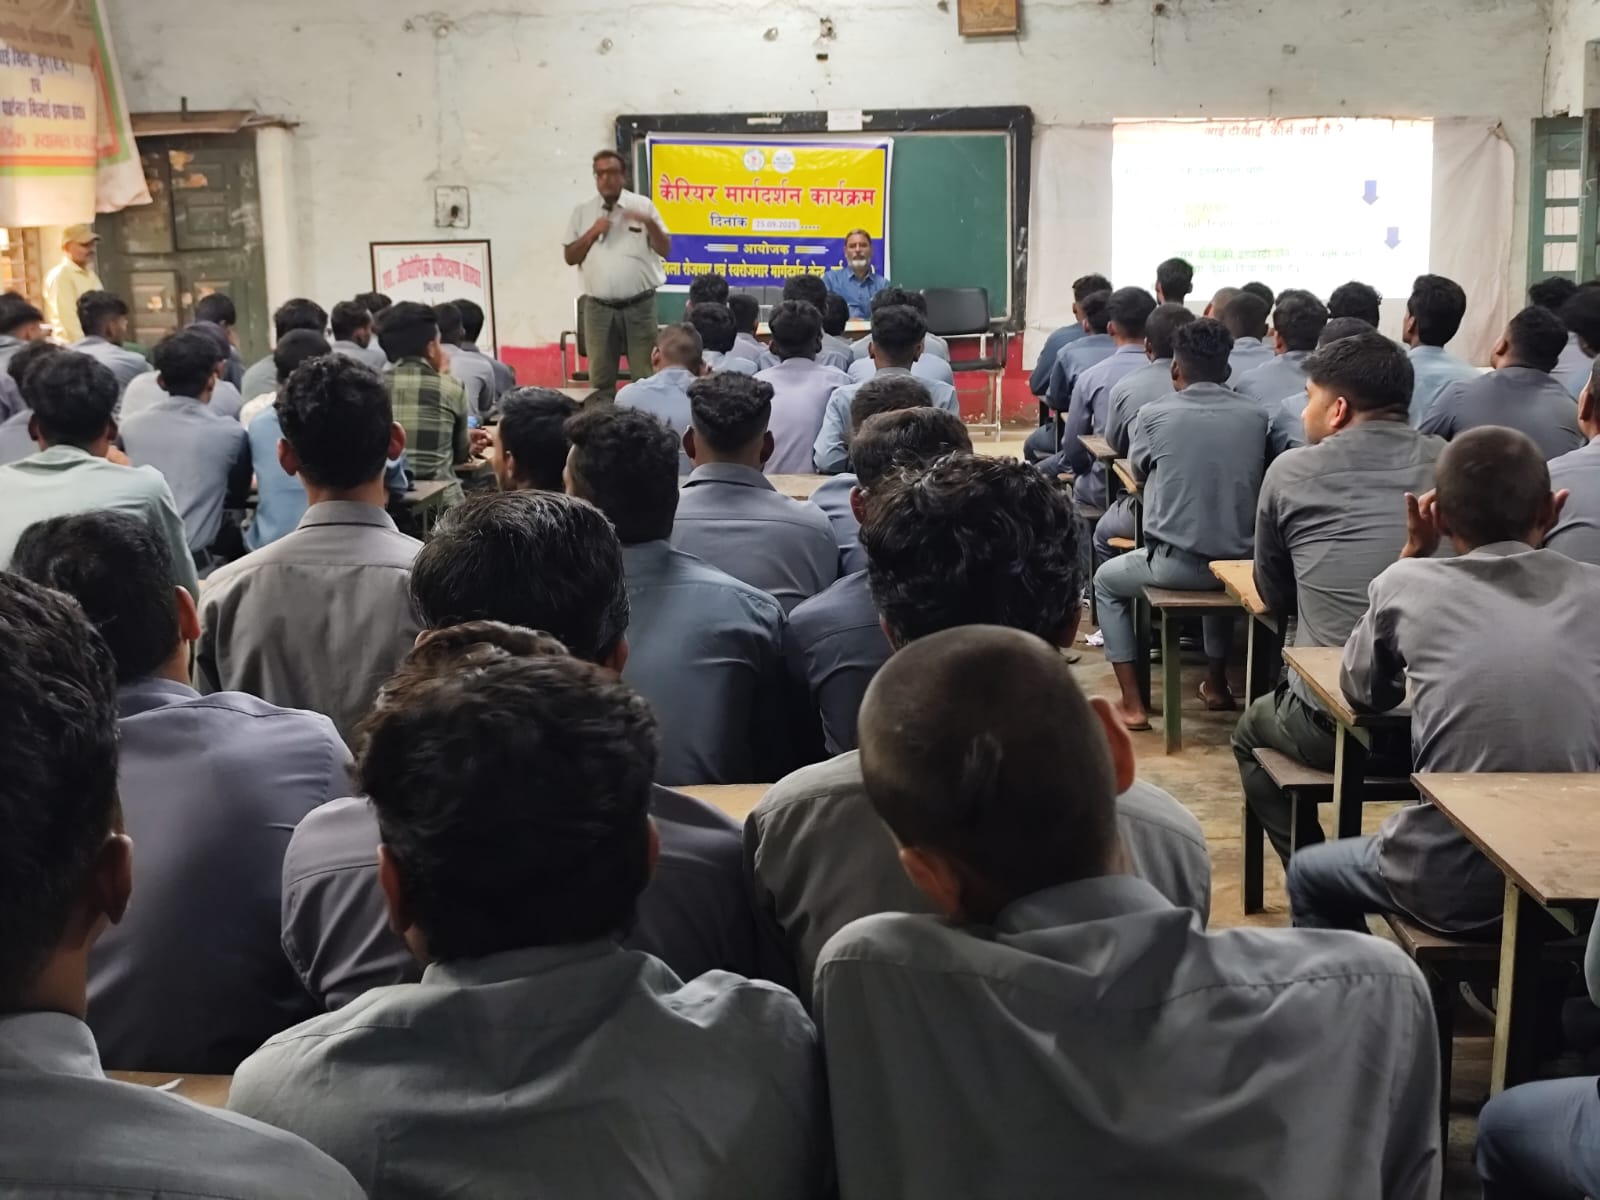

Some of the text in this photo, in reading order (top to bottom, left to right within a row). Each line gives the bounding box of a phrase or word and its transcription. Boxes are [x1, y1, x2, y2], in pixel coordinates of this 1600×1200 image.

[659, 174, 876, 206] कैरियर मार्गदर्शन कार्यक्रम
[710, 212, 748, 227] दिनांक
[743, 240, 790, 255] आयोजक
